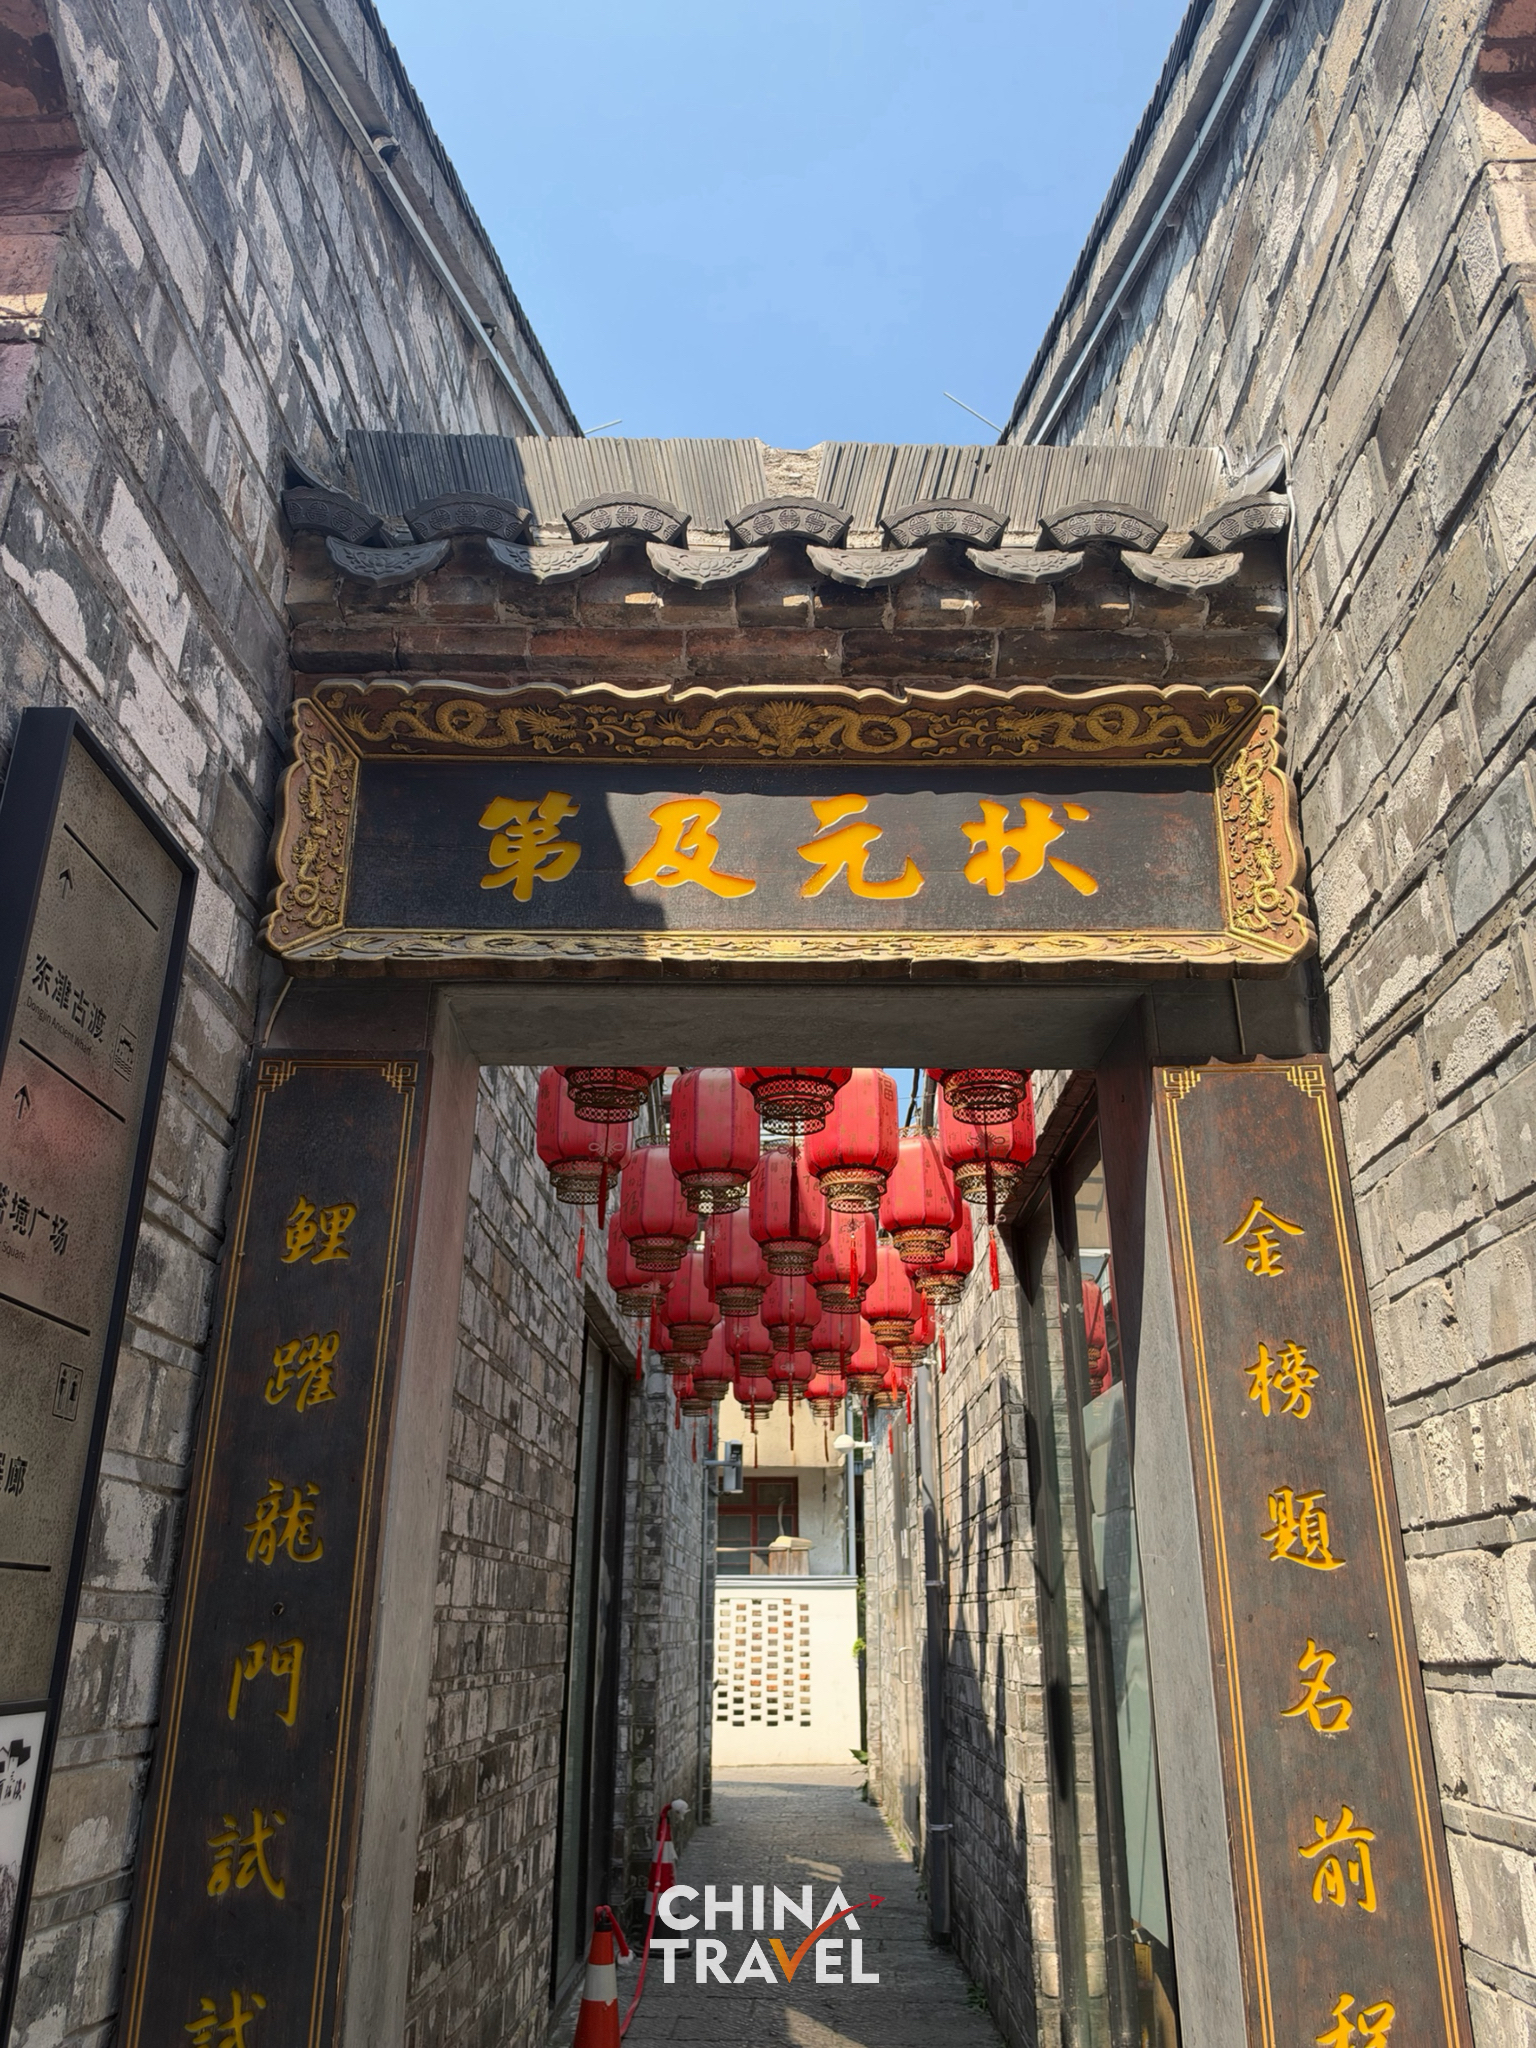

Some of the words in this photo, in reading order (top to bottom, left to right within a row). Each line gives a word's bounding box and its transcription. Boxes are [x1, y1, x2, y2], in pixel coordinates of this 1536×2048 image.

[26, 995, 52, 1023] Dongjin
[51, 1017, 76, 1041] Ancient
[32, 953, 107, 1043] 东津古渡
[2, 1240, 26, 1263] Square
[0, 1452, 28, 1497] 廊
